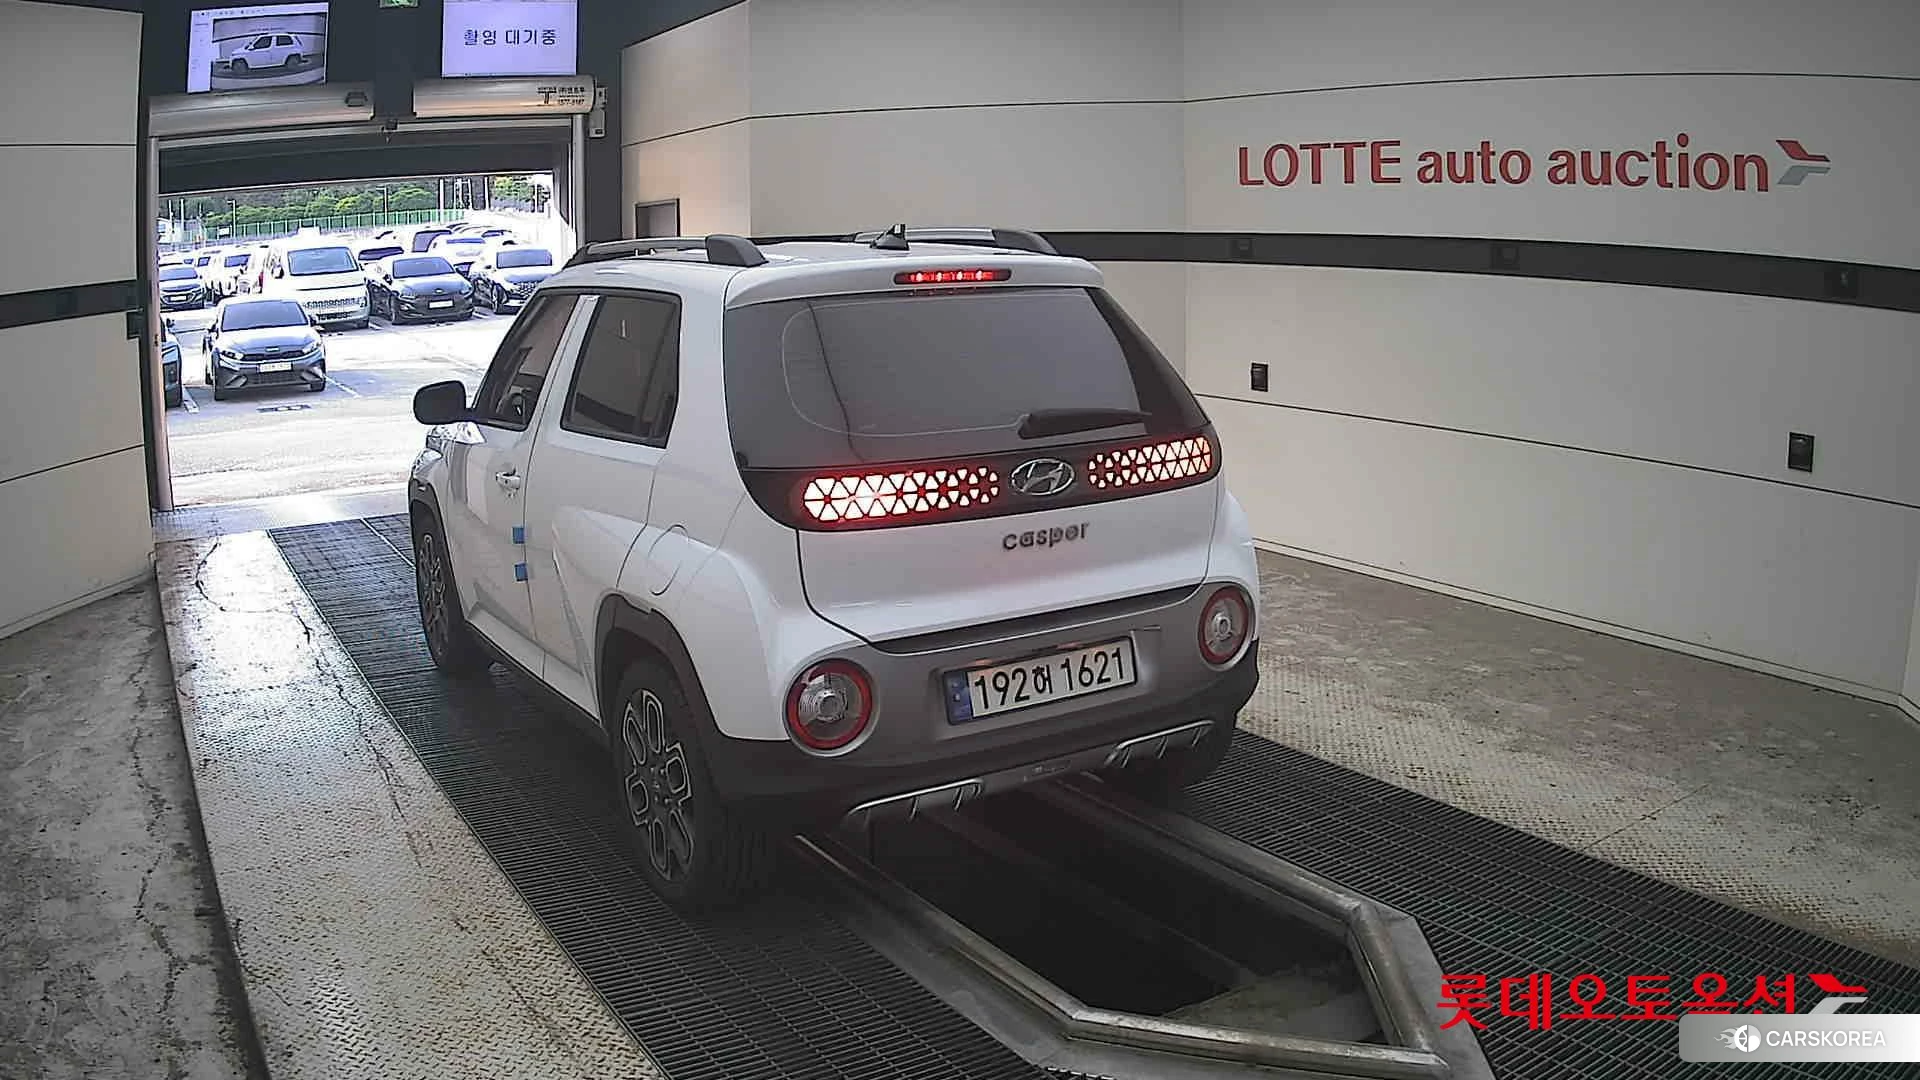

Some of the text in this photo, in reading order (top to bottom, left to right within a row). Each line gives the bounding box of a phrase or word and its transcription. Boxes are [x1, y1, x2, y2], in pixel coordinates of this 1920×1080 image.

[464, 29, 557, 46] 촬영 대기중
[1239, 133, 1769, 193] LOTTE auto auction
[1003, 522, 1090, 550] casper
[974, 646, 1126, 710] 192허 1621
